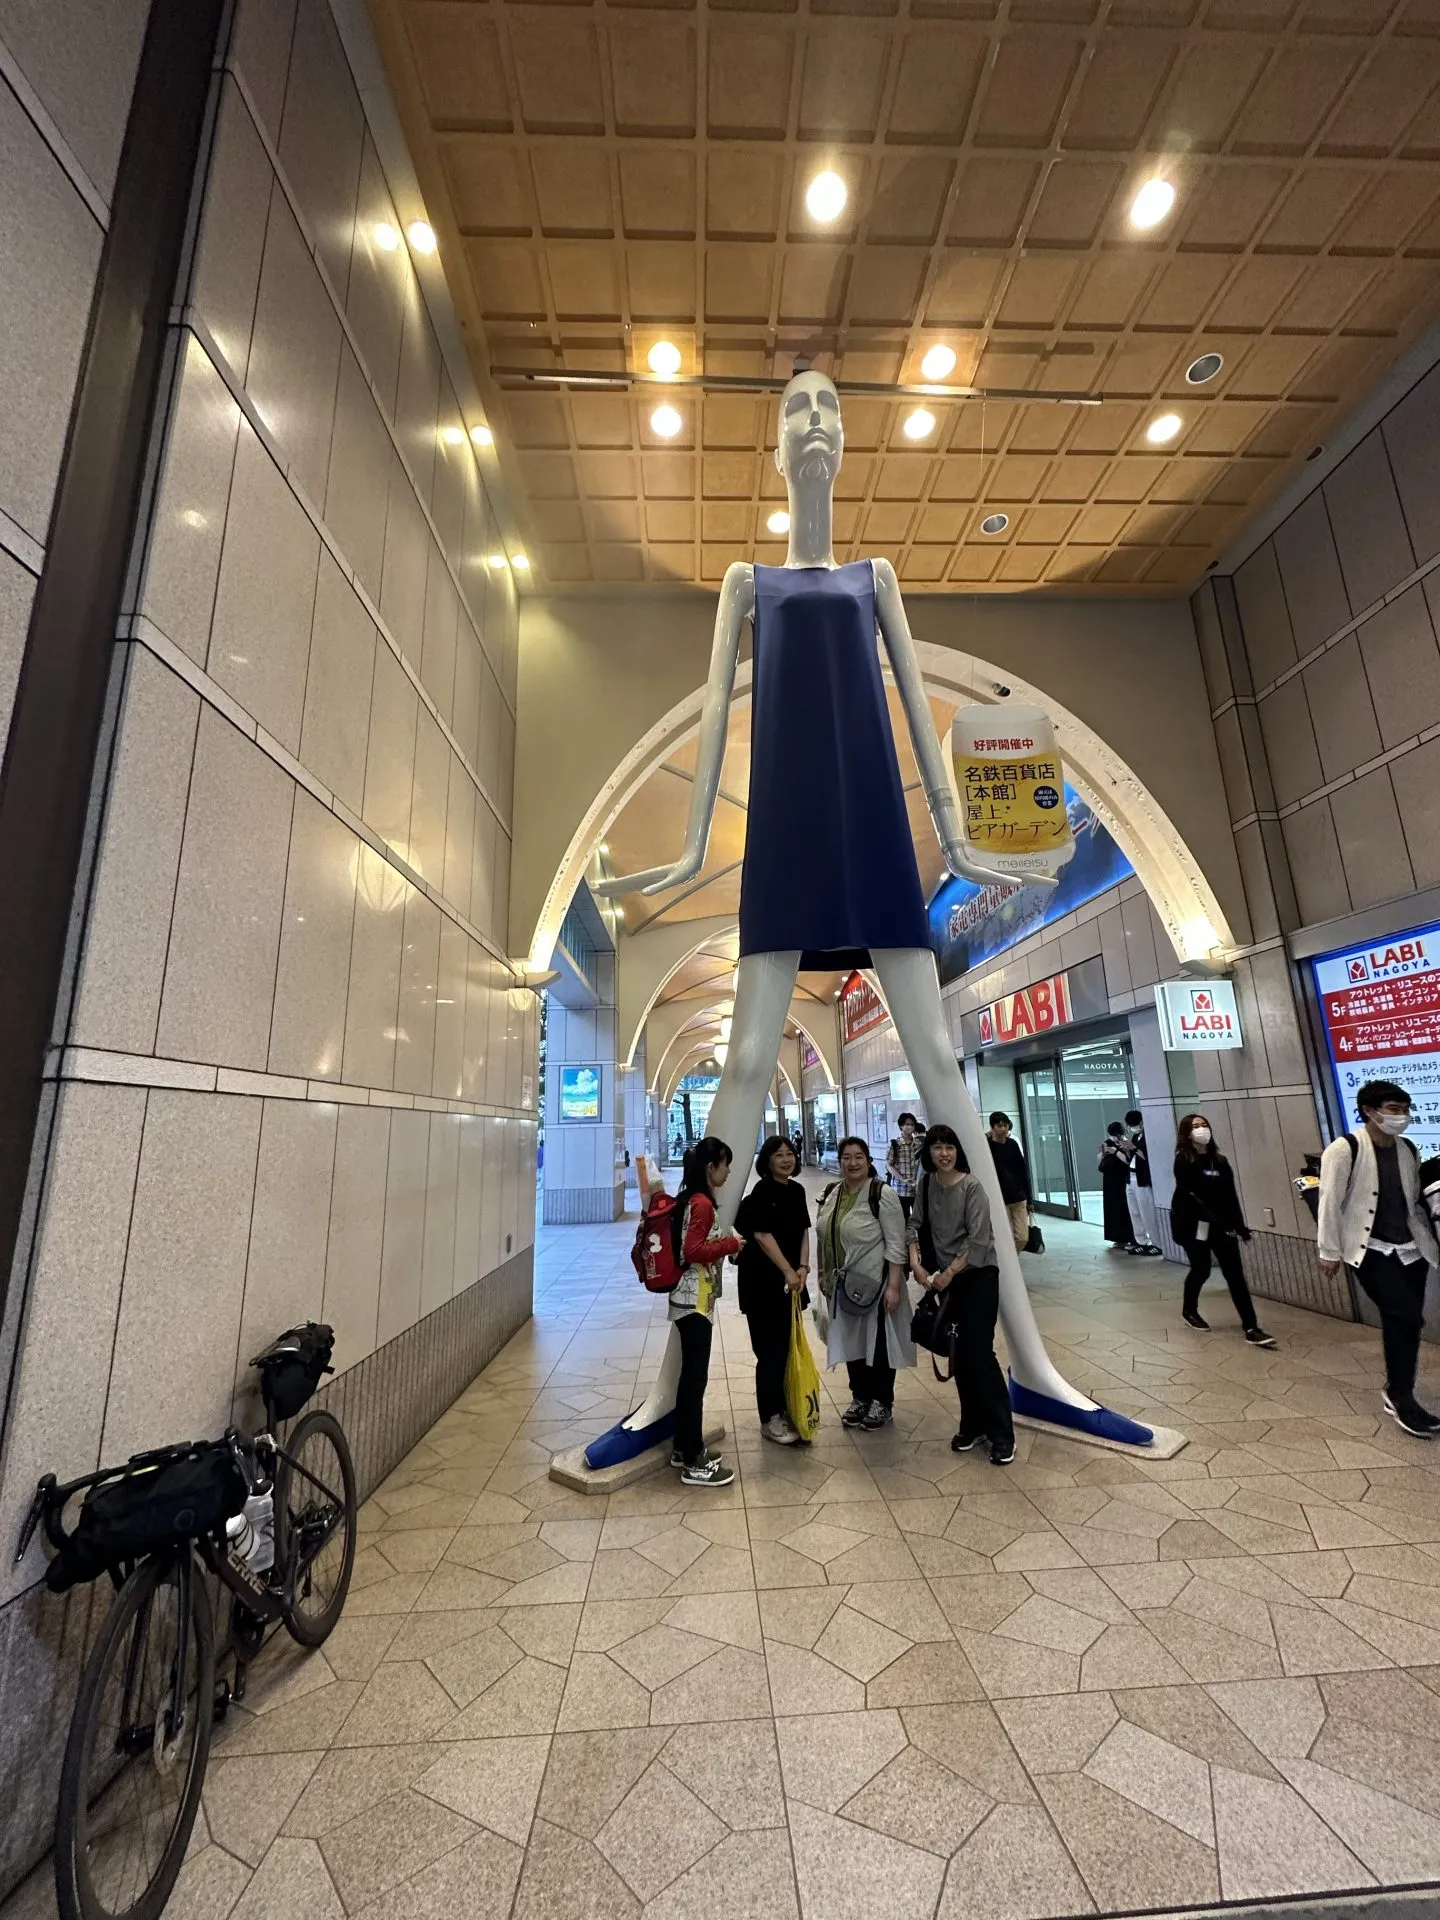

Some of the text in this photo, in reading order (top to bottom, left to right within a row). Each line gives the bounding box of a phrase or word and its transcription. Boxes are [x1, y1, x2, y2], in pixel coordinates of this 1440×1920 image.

[973, 738, 1034, 752] 好評開催中
[964, 763, 1056, 782] 名鉄百貨店
[967, 804, 1004, 821] 屋上
[967, 820, 1067, 841] ビアガーデン
[1369, 940, 1425, 970] LABI
[1373, 958, 1431, 979] NAGOYA
[994, 974, 1068, 1041] LABI
[1331, 1001, 1347, 1018] 5F
[1180, 1014, 1232, 1031] LABI
[1339, 1036, 1354, 1052] 4F
[1346, 1071, 1361, 1088] 3F
[1353, 1108, 1364, 1124] 2
